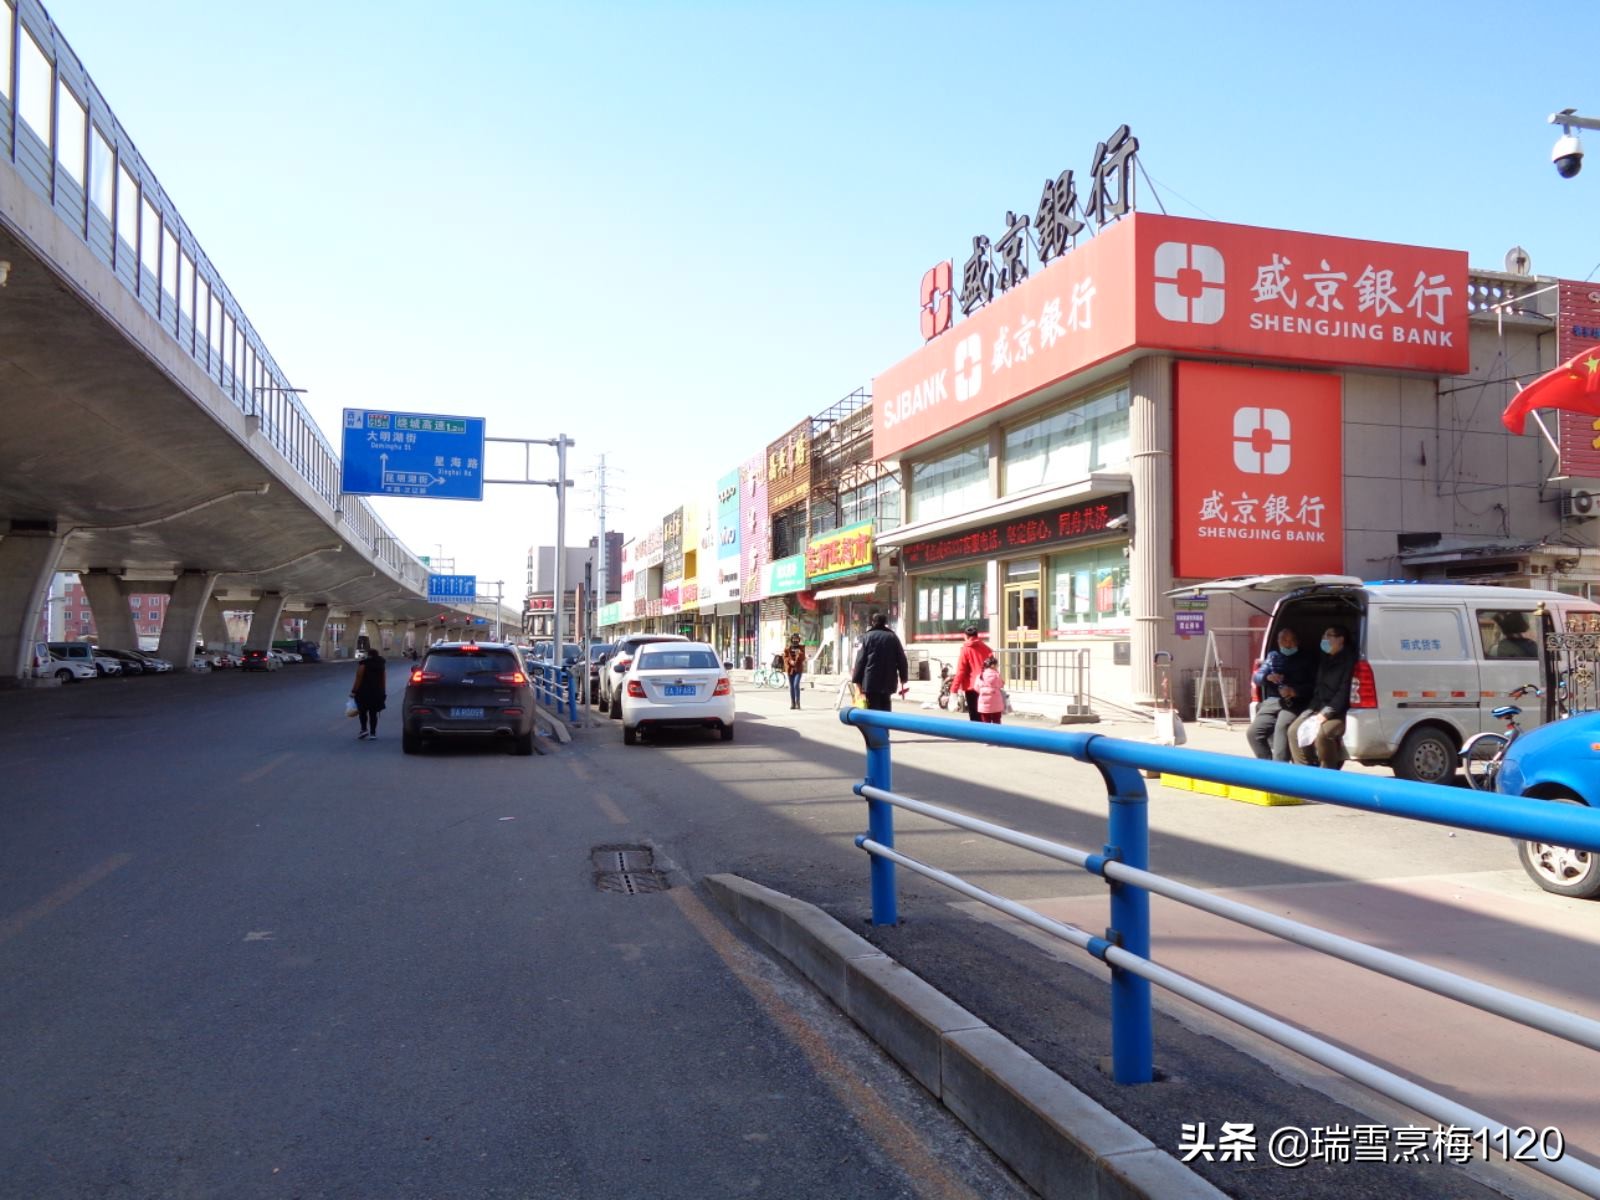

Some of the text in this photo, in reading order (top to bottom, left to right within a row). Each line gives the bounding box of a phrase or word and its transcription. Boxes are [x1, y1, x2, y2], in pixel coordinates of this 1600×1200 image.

[961, 124, 1139, 316] 盛京銀行
[1250, 253, 1453, 325] 盛京銀行
[991, 277, 1096, 374] 盛京銀行
[1250, 313, 1454, 348] SHENGJING BANK
[883, 367, 948, 429] SJBANK
[367, 431, 417, 444] 大明湖街
[1198, 490, 1326, 528] 盛京銀行
[1198, 526, 1326, 543] SHENGJING BANK
